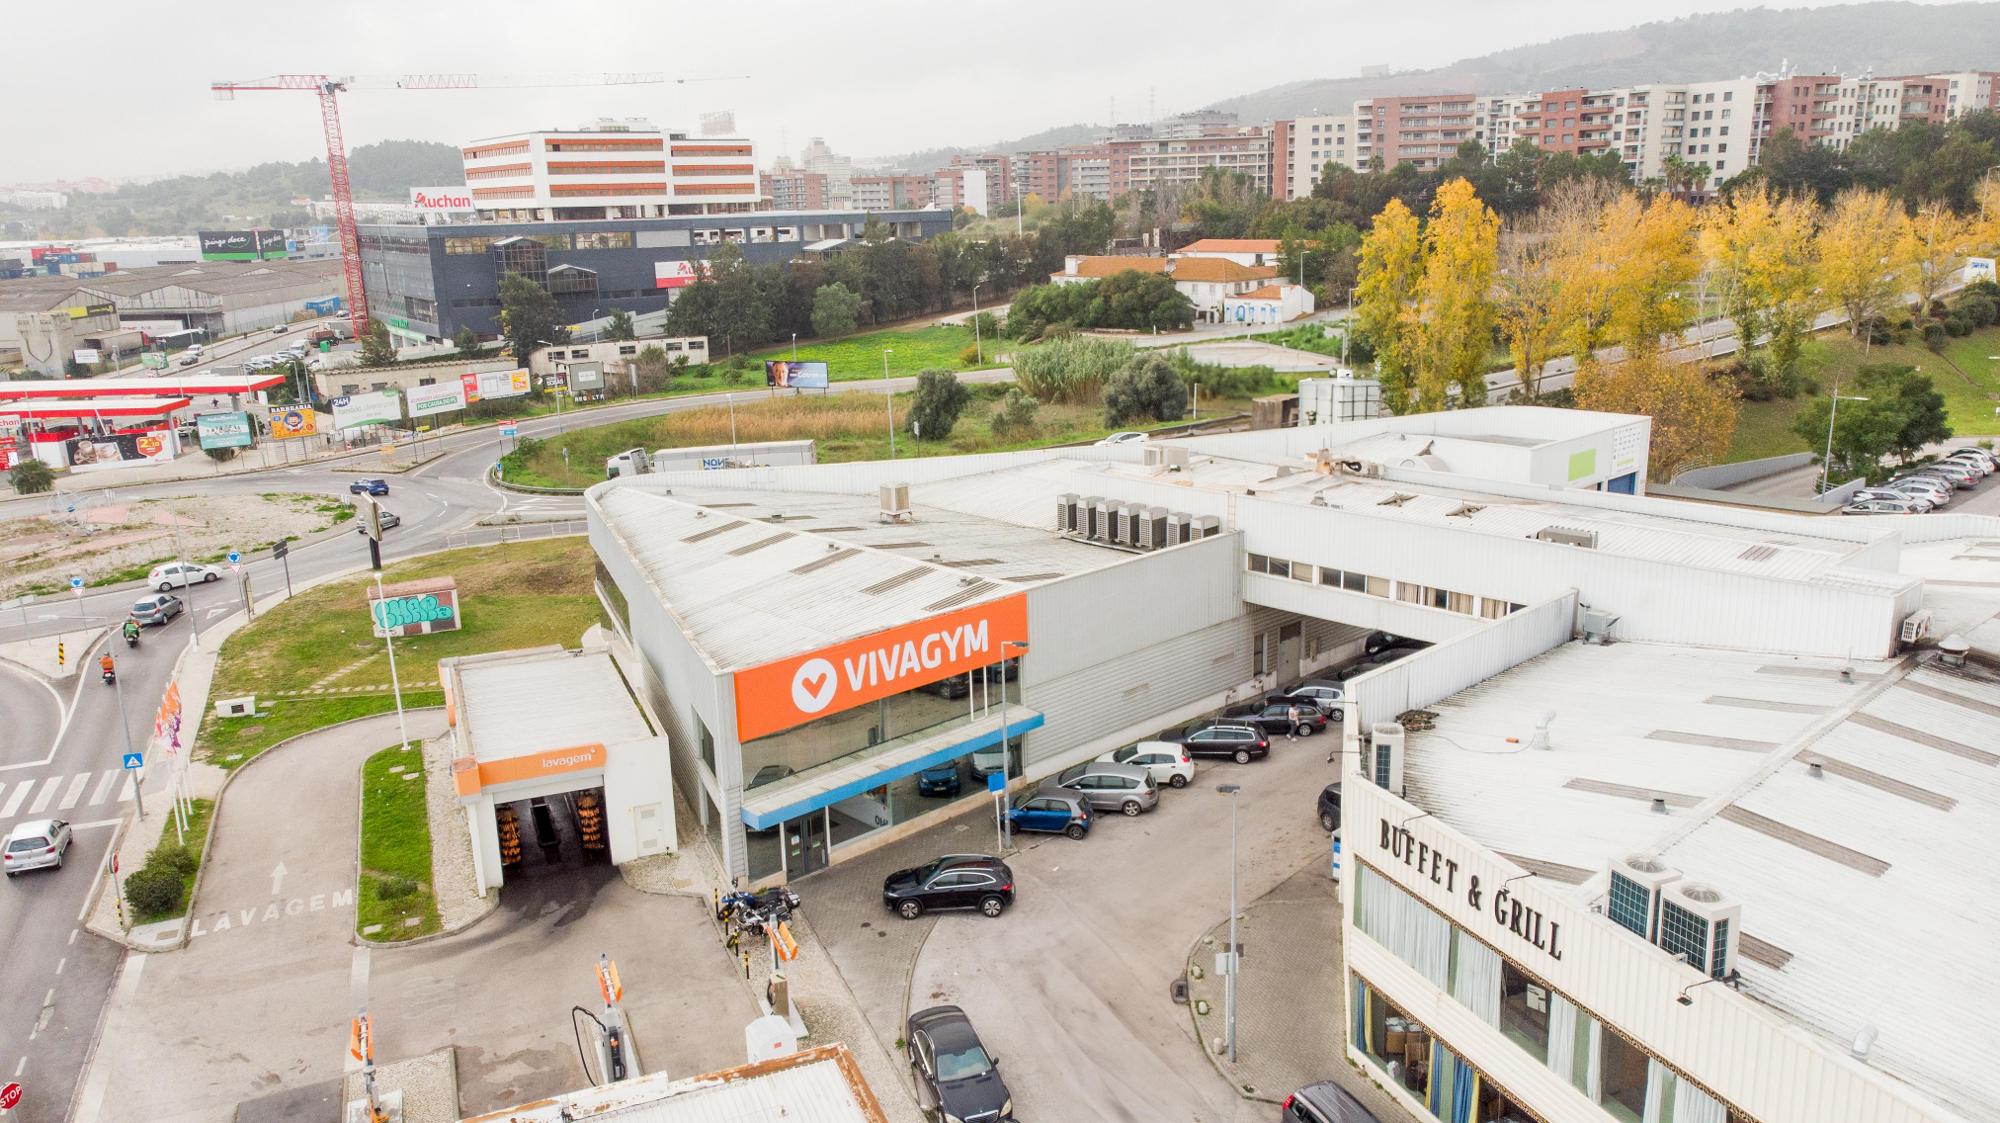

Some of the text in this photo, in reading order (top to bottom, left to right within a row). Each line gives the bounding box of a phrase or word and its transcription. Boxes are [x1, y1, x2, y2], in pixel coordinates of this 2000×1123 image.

[414, 192, 471, 208] Auchan
[204, 235, 247, 249] pingo doce
[333, 397, 349, 406] 24H
[843, 619, 988, 692] VIVAGYM
[542, 753, 592, 768] lavagem
[1379, 818, 1562, 960] BUFFET & GRILL
[190, 888, 353, 938] LAVAGEM
[0, 1085, 21, 1107] STOP
